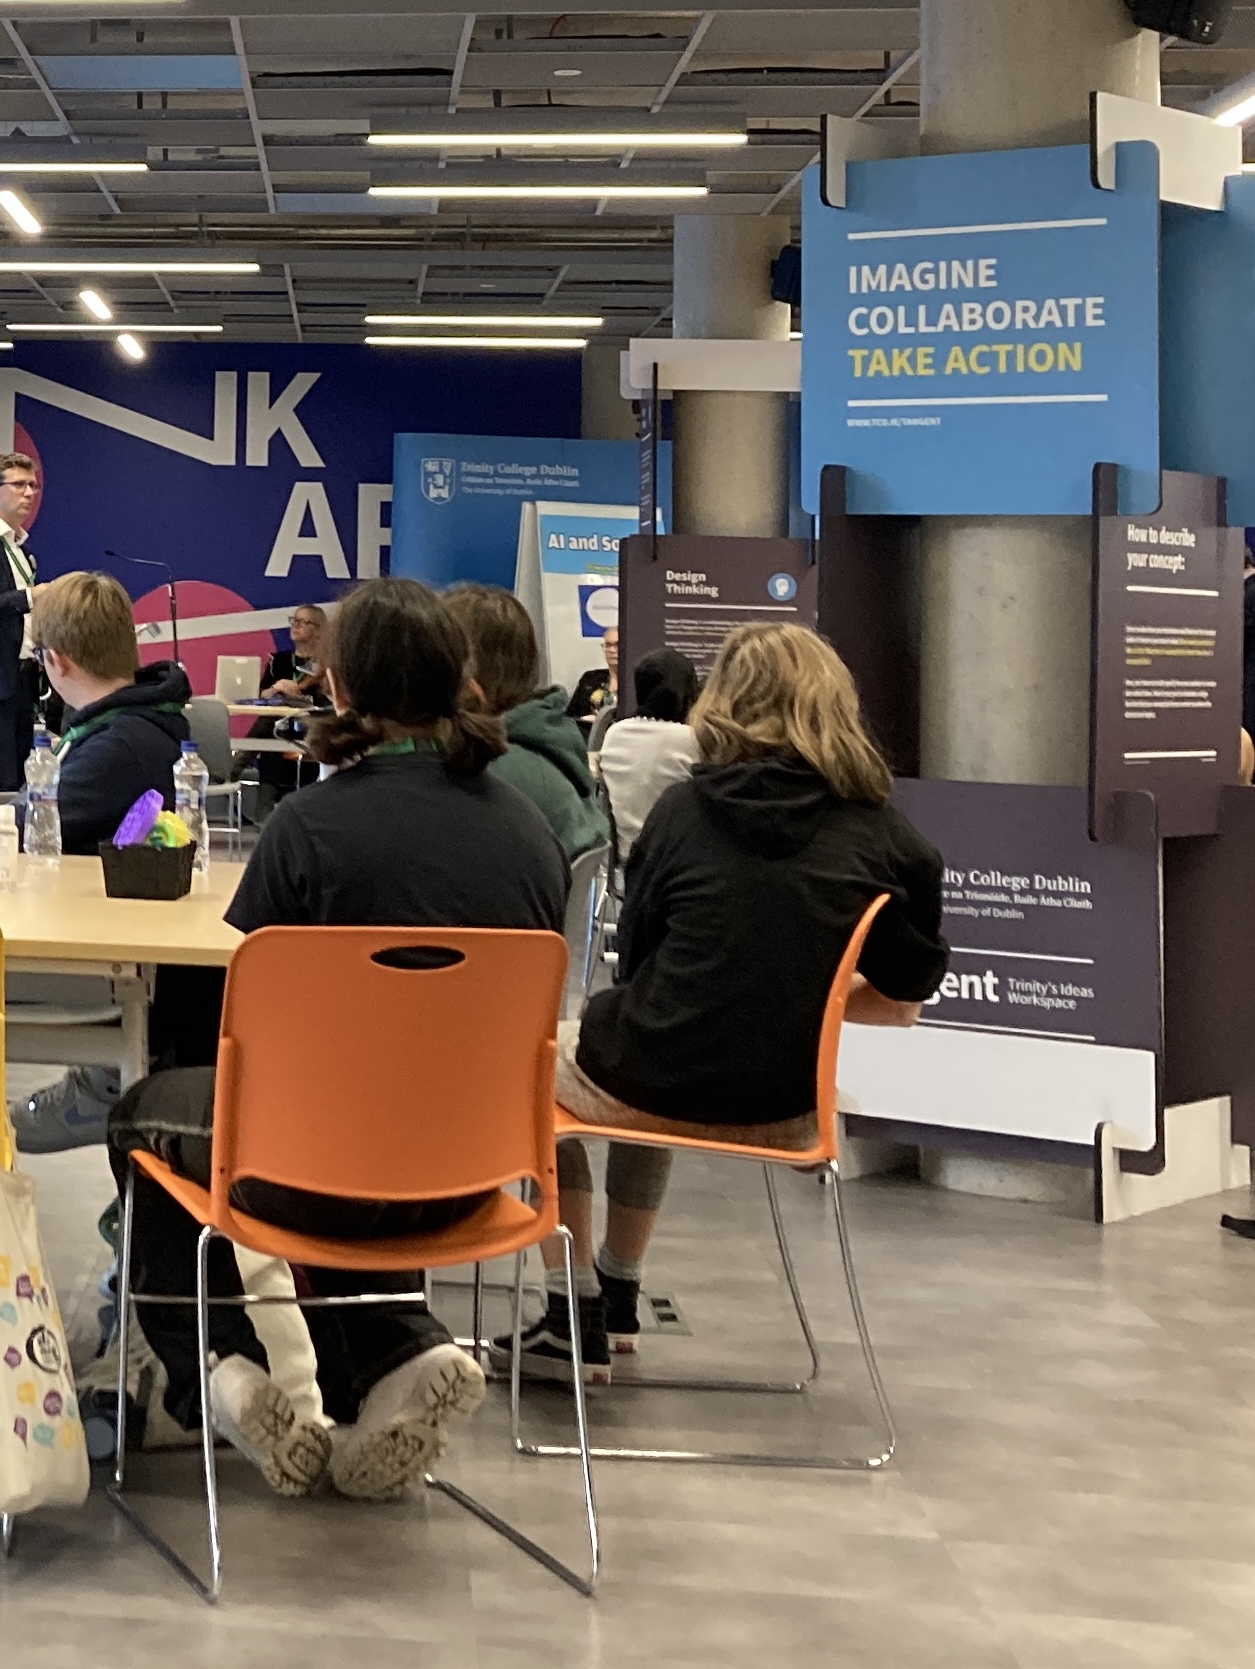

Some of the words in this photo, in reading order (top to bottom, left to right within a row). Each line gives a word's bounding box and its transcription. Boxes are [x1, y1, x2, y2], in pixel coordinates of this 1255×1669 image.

[848, 258, 998, 294] IMAGINE
[847, 296, 1106, 336] COLLABORATE
[847, 345, 936, 378] TAKE
[944, 342, 1083, 376] ACTION
[497, 463, 538, 477] College
[540, 464, 579, 477] Dublin
[548, 533, 565, 549] AI
[568, 534, 598, 551] and
[602, 536, 620, 552] So
[1127, 523, 1148, 542] How
[1149, 526, 1159, 545] to
[1159, 526, 1196, 548] describe
[1127, 552, 1148, 571] your
[666, 570, 706, 584] Design
[666, 584, 719, 598] Thinking
[943, 867, 966, 888] ity
[969, 870, 1030, 891] College
[1034, 874, 1092, 894] Dublin
[992, 908, 1025, 919] Dublin
[926, 969, 1000, 1004] ent
[1008, 977, 1057, 996] Trinity's
[1061, 983, 1095, 998] Ideas
[1007, 992, 1078, 1010] Workspace
